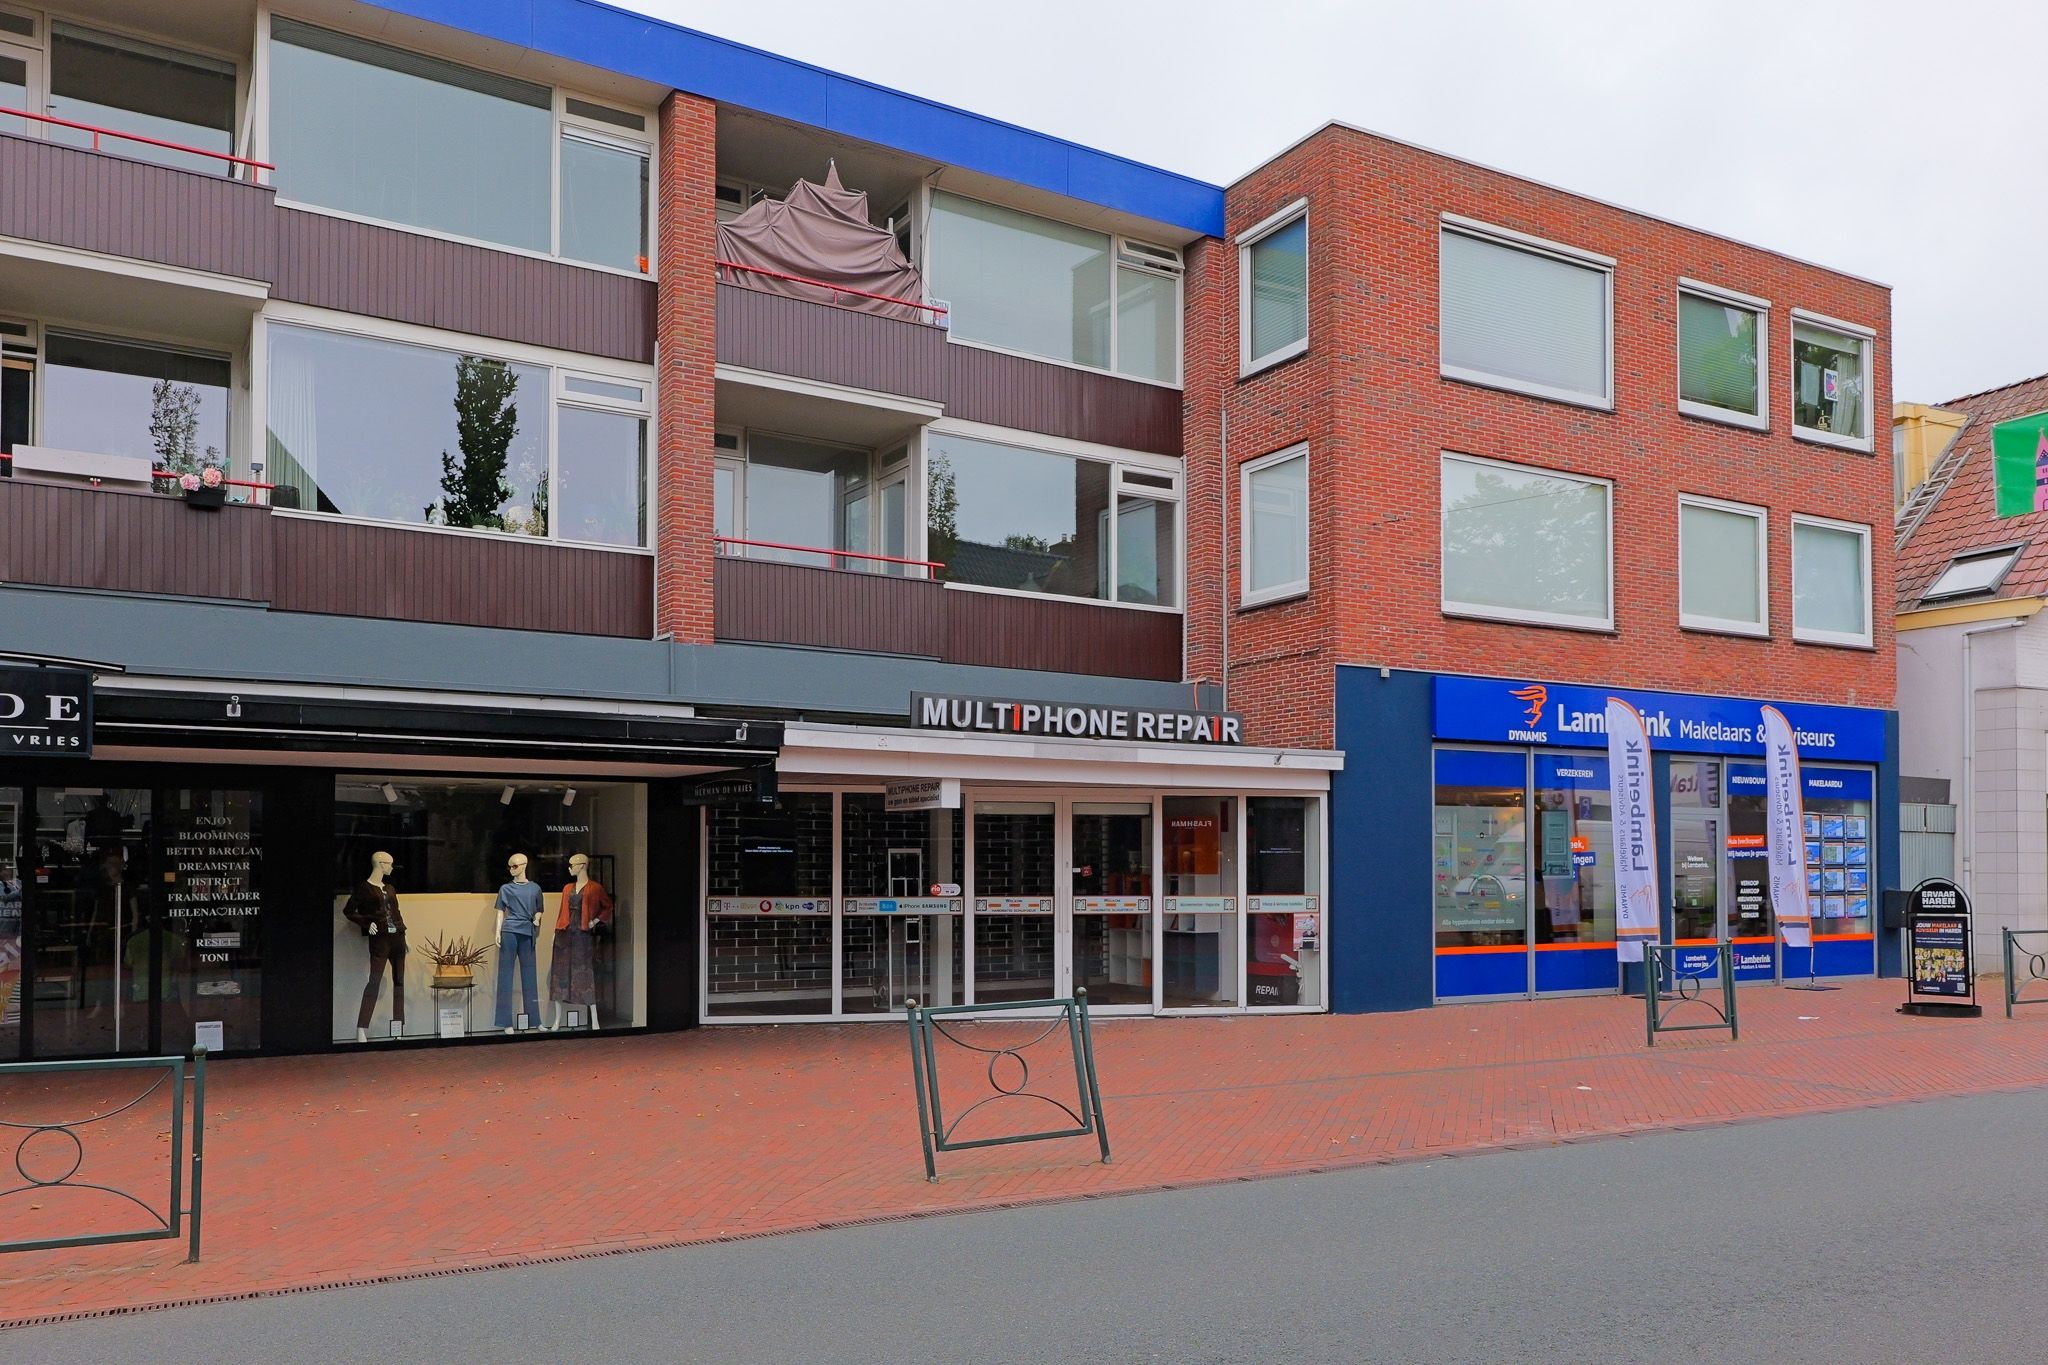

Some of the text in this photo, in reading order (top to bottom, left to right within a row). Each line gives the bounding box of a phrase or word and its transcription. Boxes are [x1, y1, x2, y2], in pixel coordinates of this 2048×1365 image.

[922, 697, 1241, 743] MULTIPHONE REPAIR
[1557, 703, 1836, 748] Lamink Makelaars & viseurs
[1508, 729, 1548, 742] DYNAMIS
[12, 734, 80, 747] VRIES
[1556, 768, 1594, 778] VERZEKEREN
[1732, 776, 1766, 785] NIEUWBOUW
[733, 784, 753, 793] VRIES
[196, 816, 234, 825] ENJOY
[179, 832, 250, 840] BLOOMINGS
[166, 847, 262, 856] BETTY BARCLAY
[178, 862, 250, 871] DREAMSTAR
[187, 878, 242, 886] DISTRICT
[168, 892, 260, 902] FRANK WALDER
[785, 903, 800, 911] kpn
[196, 938, 232, 947] RESET
[199, 953, 229, 962] TONI
[1740, 954, 1771, 964] Lamberink
[1255, 984, 1279, 996] REPAI
